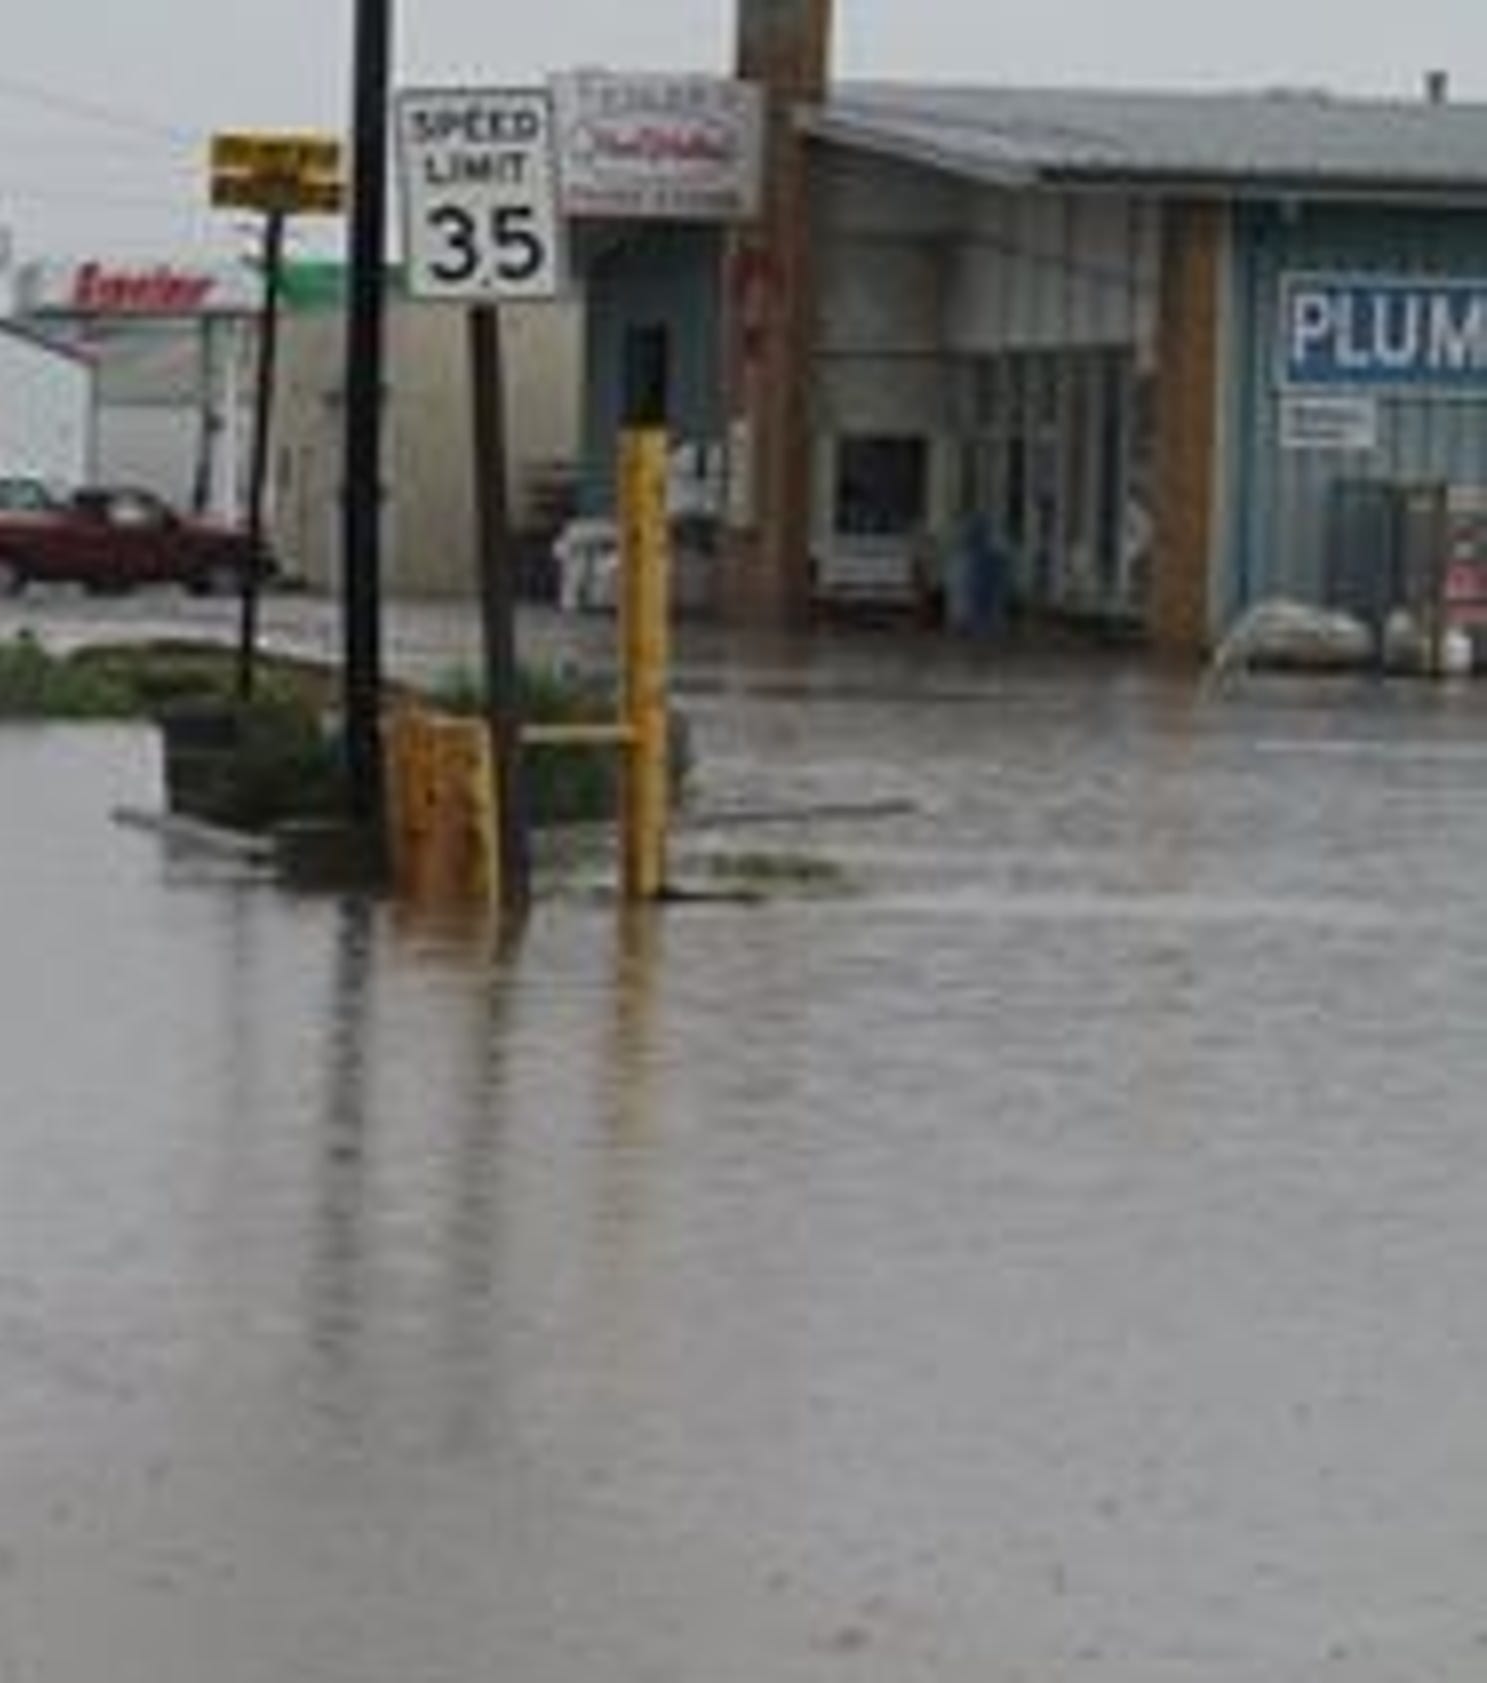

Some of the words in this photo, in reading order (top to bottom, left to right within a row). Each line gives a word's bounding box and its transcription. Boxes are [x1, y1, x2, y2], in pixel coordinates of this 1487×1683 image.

[412, 109, 540, 142] SPEED
[425, 151, 528, 184] LIMIT
[427, 204, 545, 281] 35
[1294, 293, 1487, 368] PLUM
